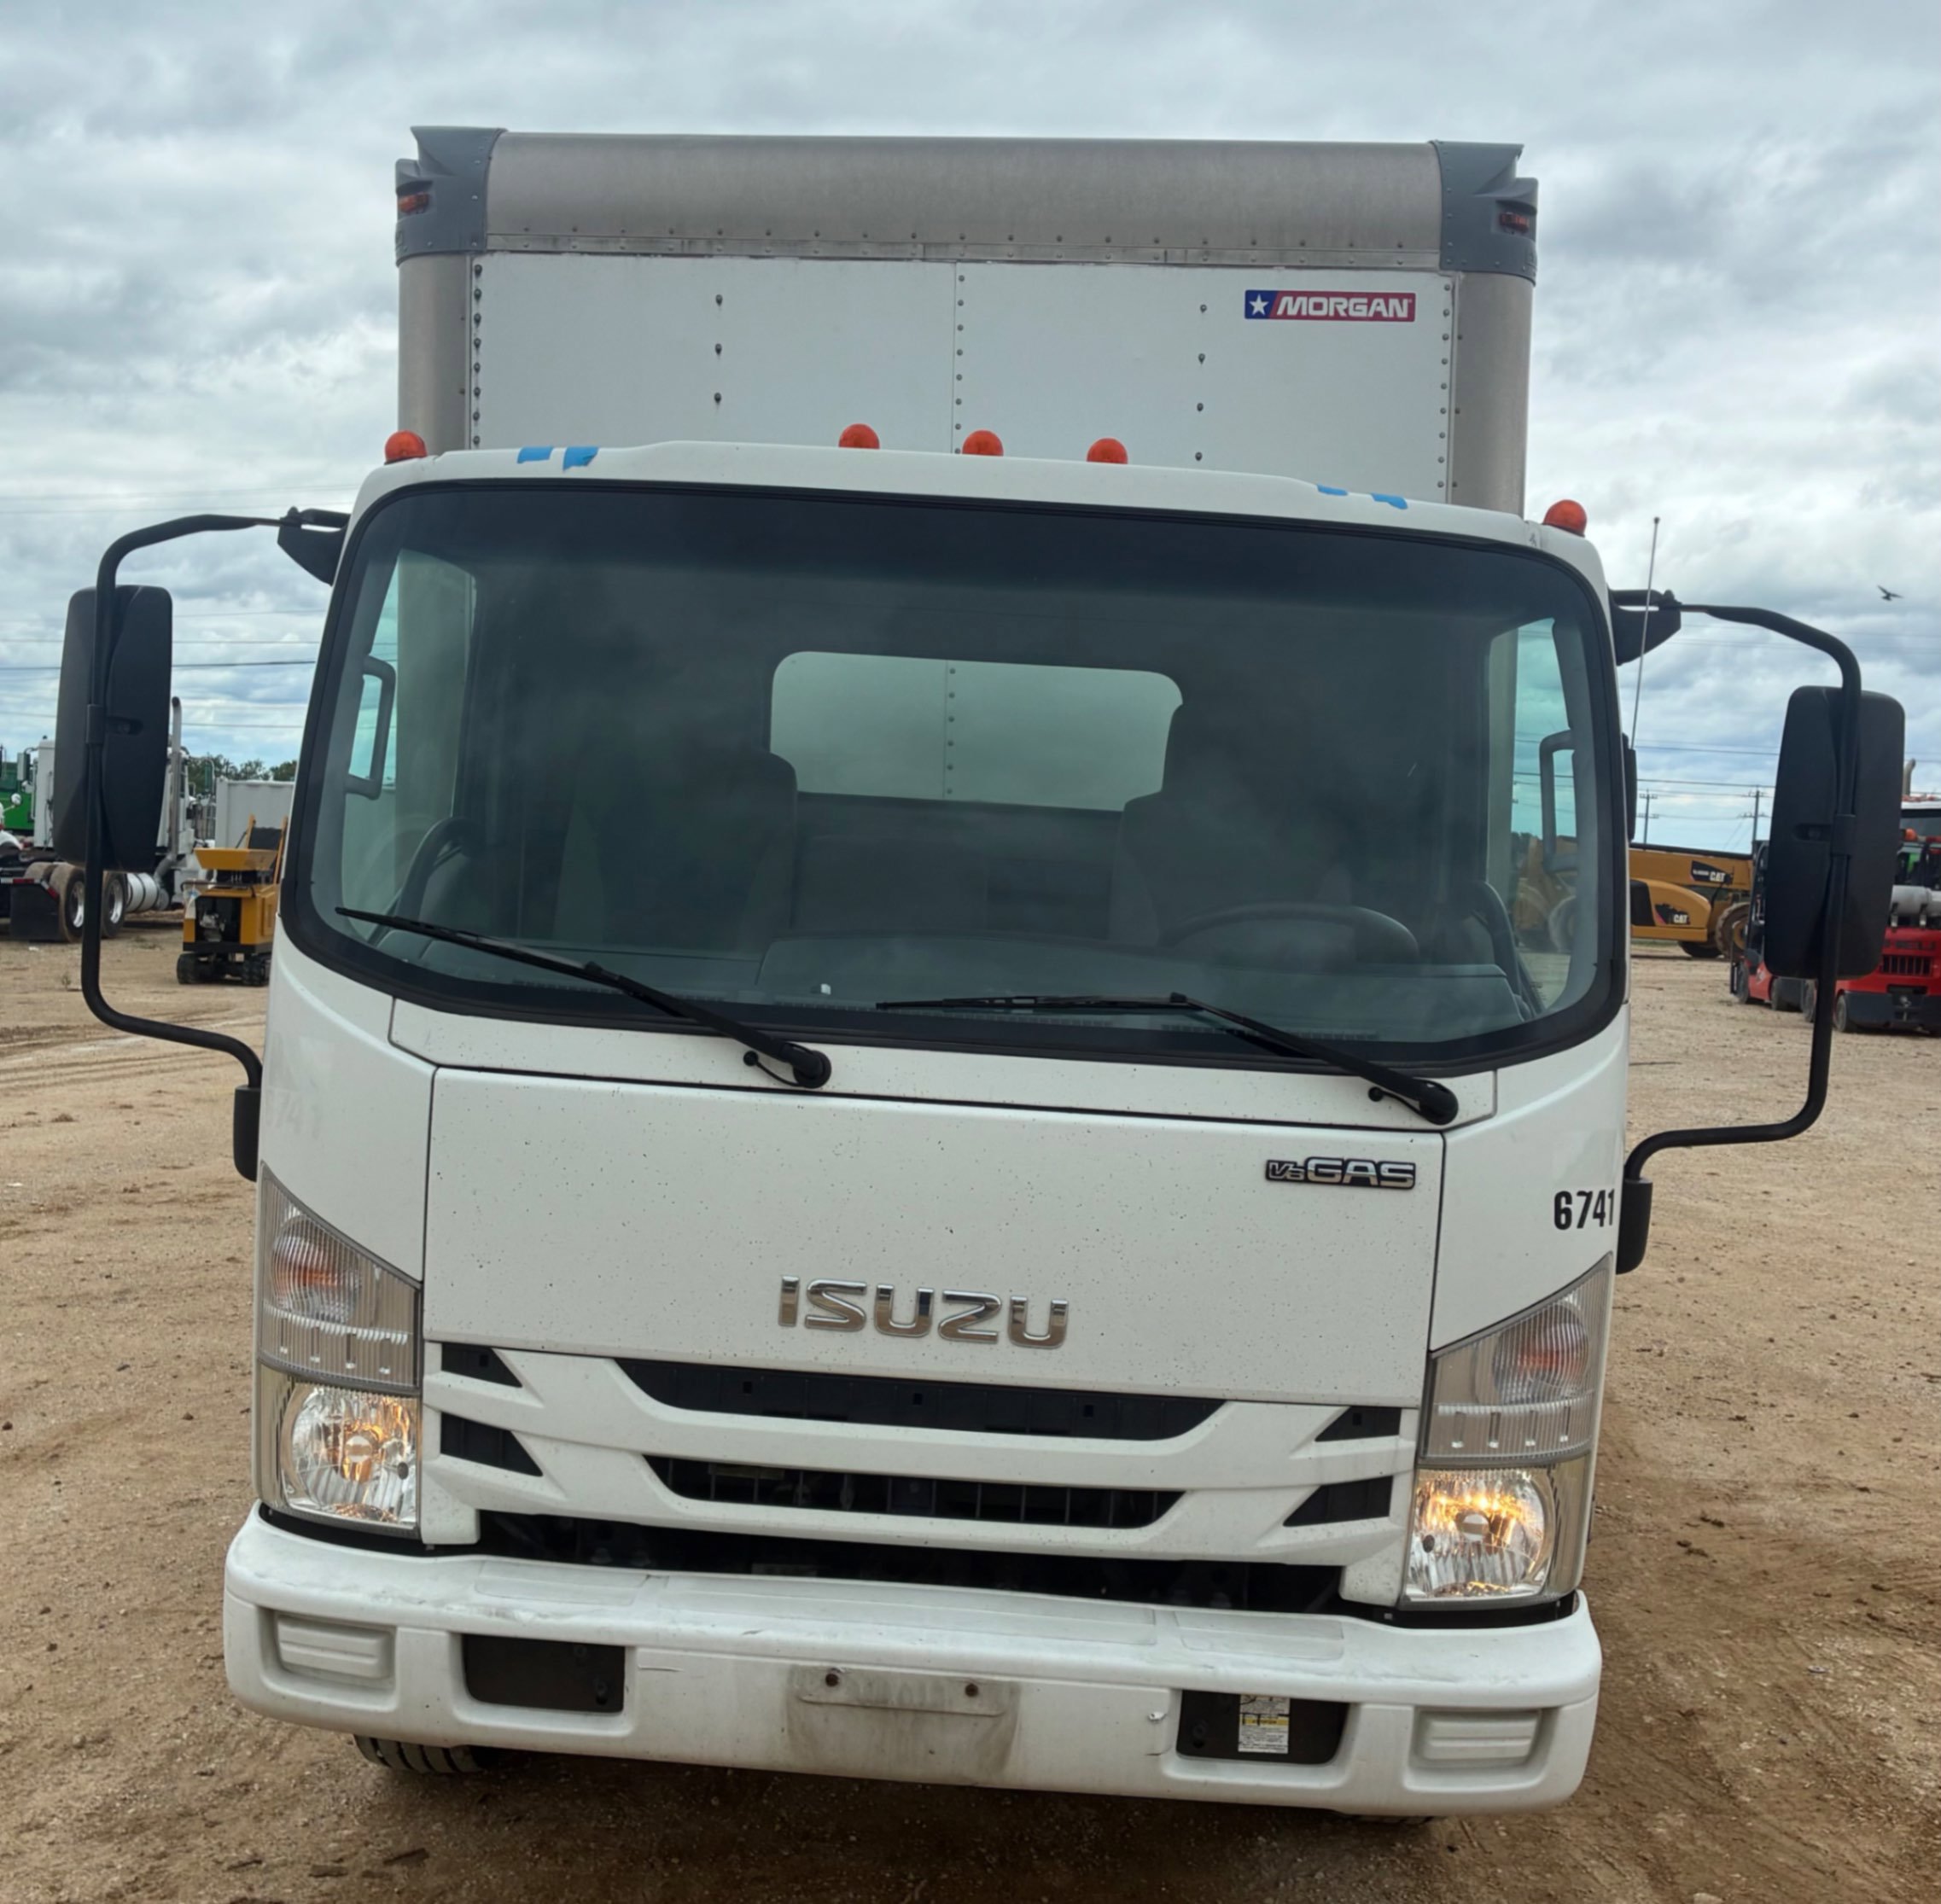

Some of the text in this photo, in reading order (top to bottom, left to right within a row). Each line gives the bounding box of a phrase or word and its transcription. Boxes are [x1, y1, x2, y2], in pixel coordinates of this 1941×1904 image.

[1277, 295, 1408, 318] MORGAN
[1710, 871, 1725, 882] CAT
[1674, 914, 1687, 923] CAT
[1554, 1188, 1615, 1231] 6741
[777, 1275, 1070, 1350] ISUZU
